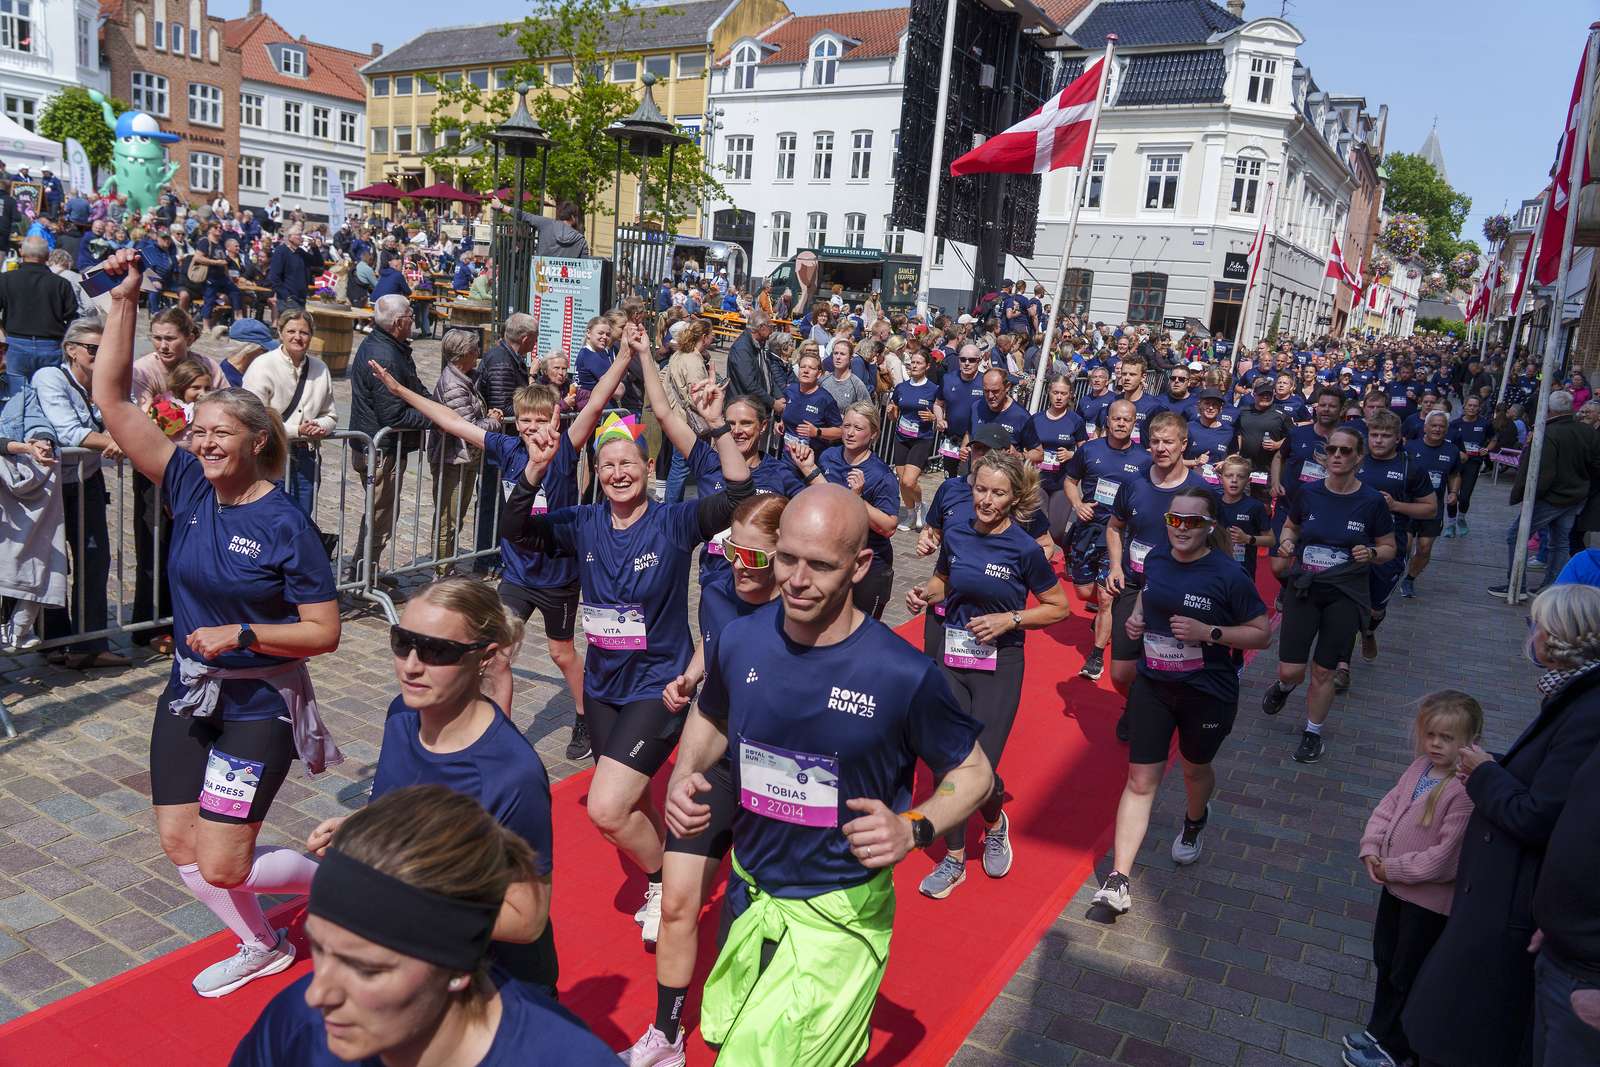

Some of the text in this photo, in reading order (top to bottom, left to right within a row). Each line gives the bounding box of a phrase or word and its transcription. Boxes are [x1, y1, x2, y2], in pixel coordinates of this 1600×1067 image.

[231, 535, 262, 552] ROYAL
[634, 552, 657, 565] ROYAL
[986, 563, 1011, 574] ROYAL
[1185, 593, 1212, 605] ROYAL
[950, 646, 969, 655] SANNE
[831, 686, 876, 707] ROYAL
[745, 748, 765, 759] ROYAL
[214, 784, 245, 798] PRESS
[766, 783, 807, 801] TOBIAS
[751, 796, 759, 807] D
[767, 799, 804, 817] 27014
